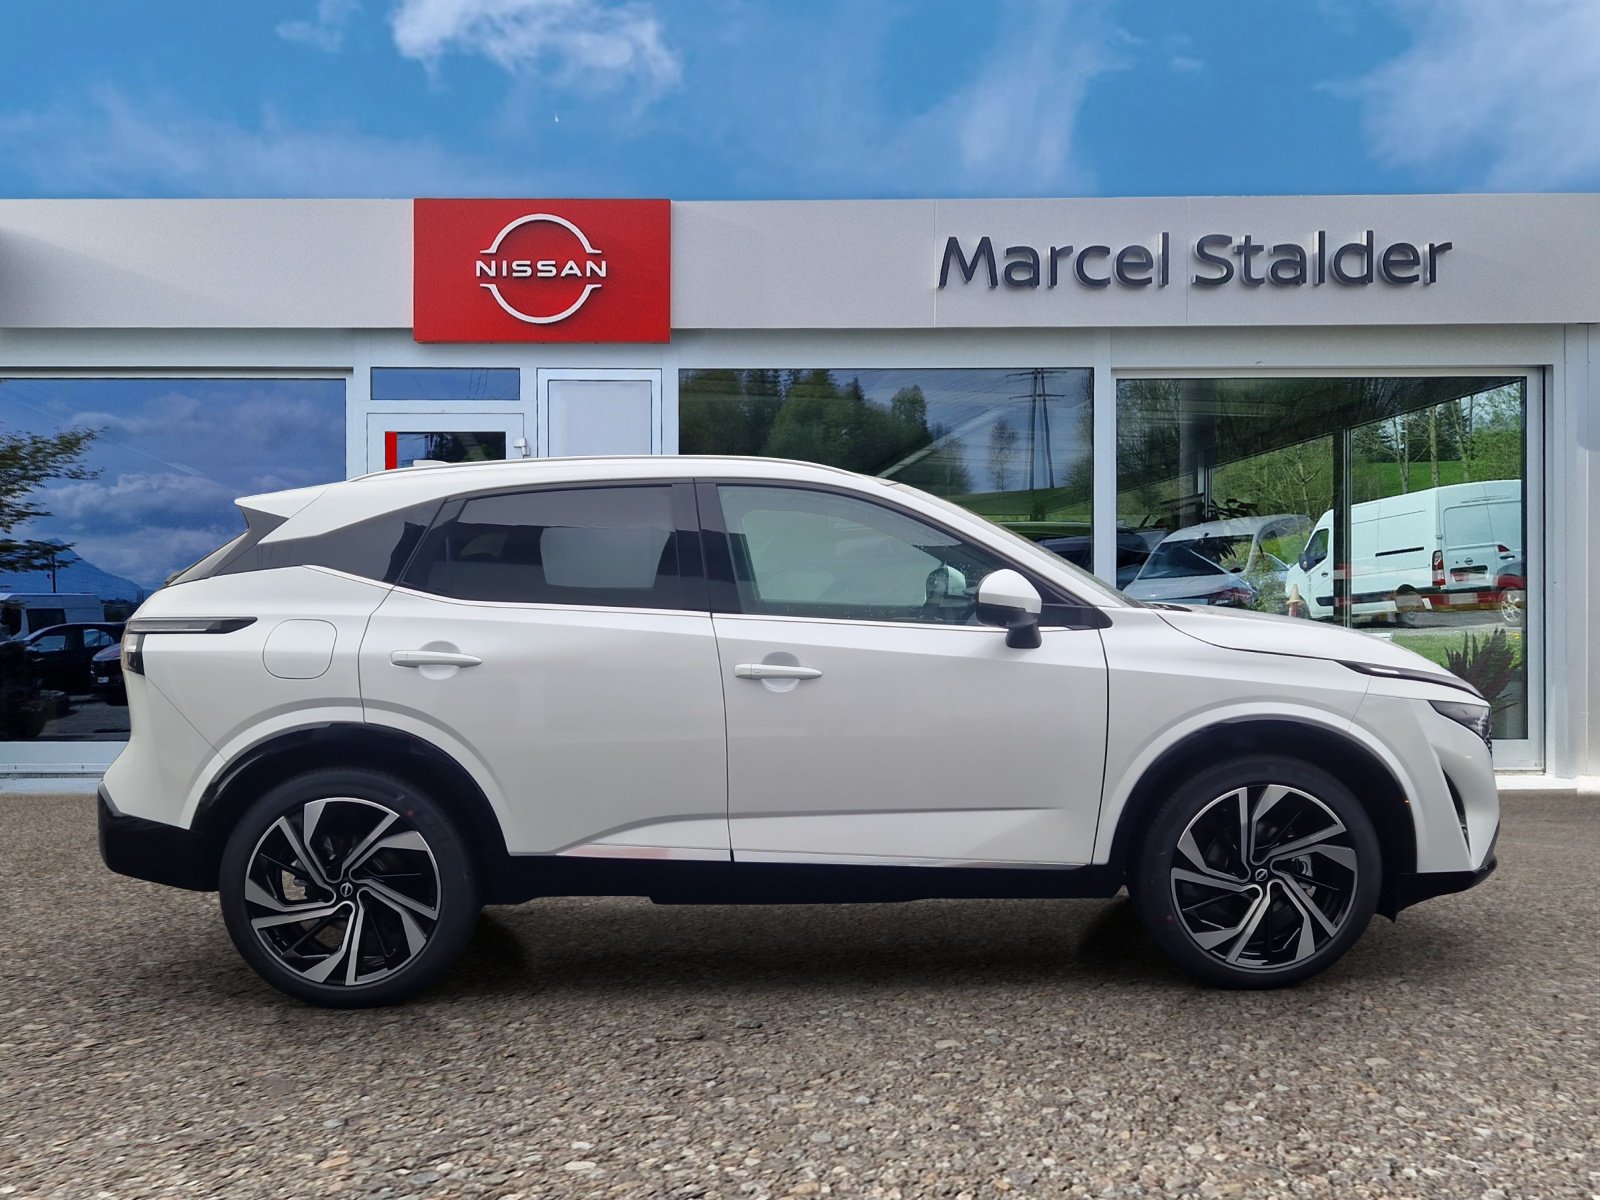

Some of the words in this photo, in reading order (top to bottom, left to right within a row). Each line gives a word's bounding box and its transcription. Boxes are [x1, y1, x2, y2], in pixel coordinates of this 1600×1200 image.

[475, 260, 607, 277] NISSAN
[938, 232, 1170, 288] Marcel
[1191, 230, 1453, 287] Stalder
